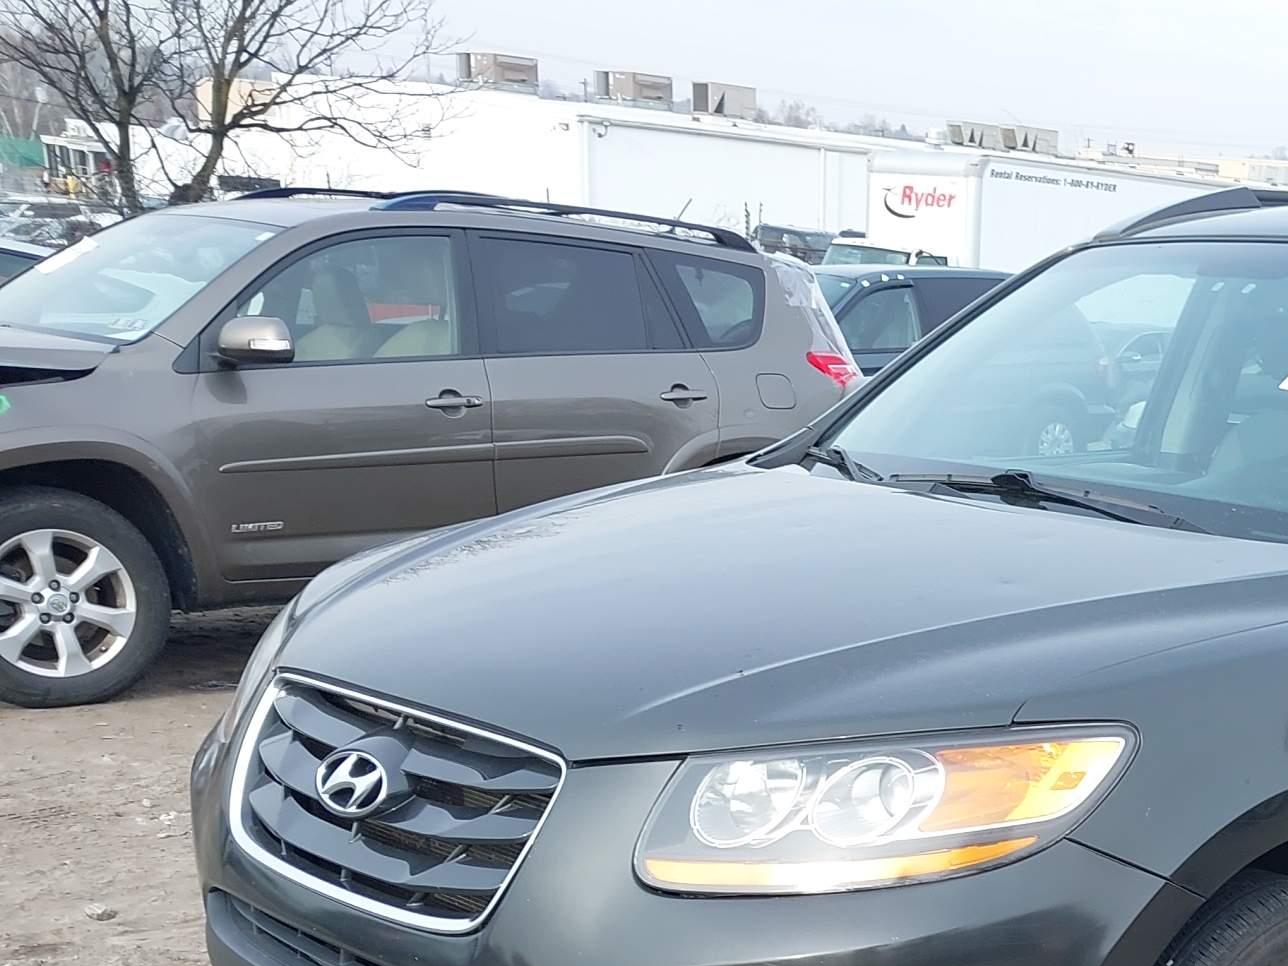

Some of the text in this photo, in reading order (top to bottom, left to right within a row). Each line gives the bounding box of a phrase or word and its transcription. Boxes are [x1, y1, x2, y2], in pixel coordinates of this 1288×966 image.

[989, 168, 1012, 181] Rental
[1015, 171, 1062, 186] Reservations:
[901, 184, 956, 211] Ryder
